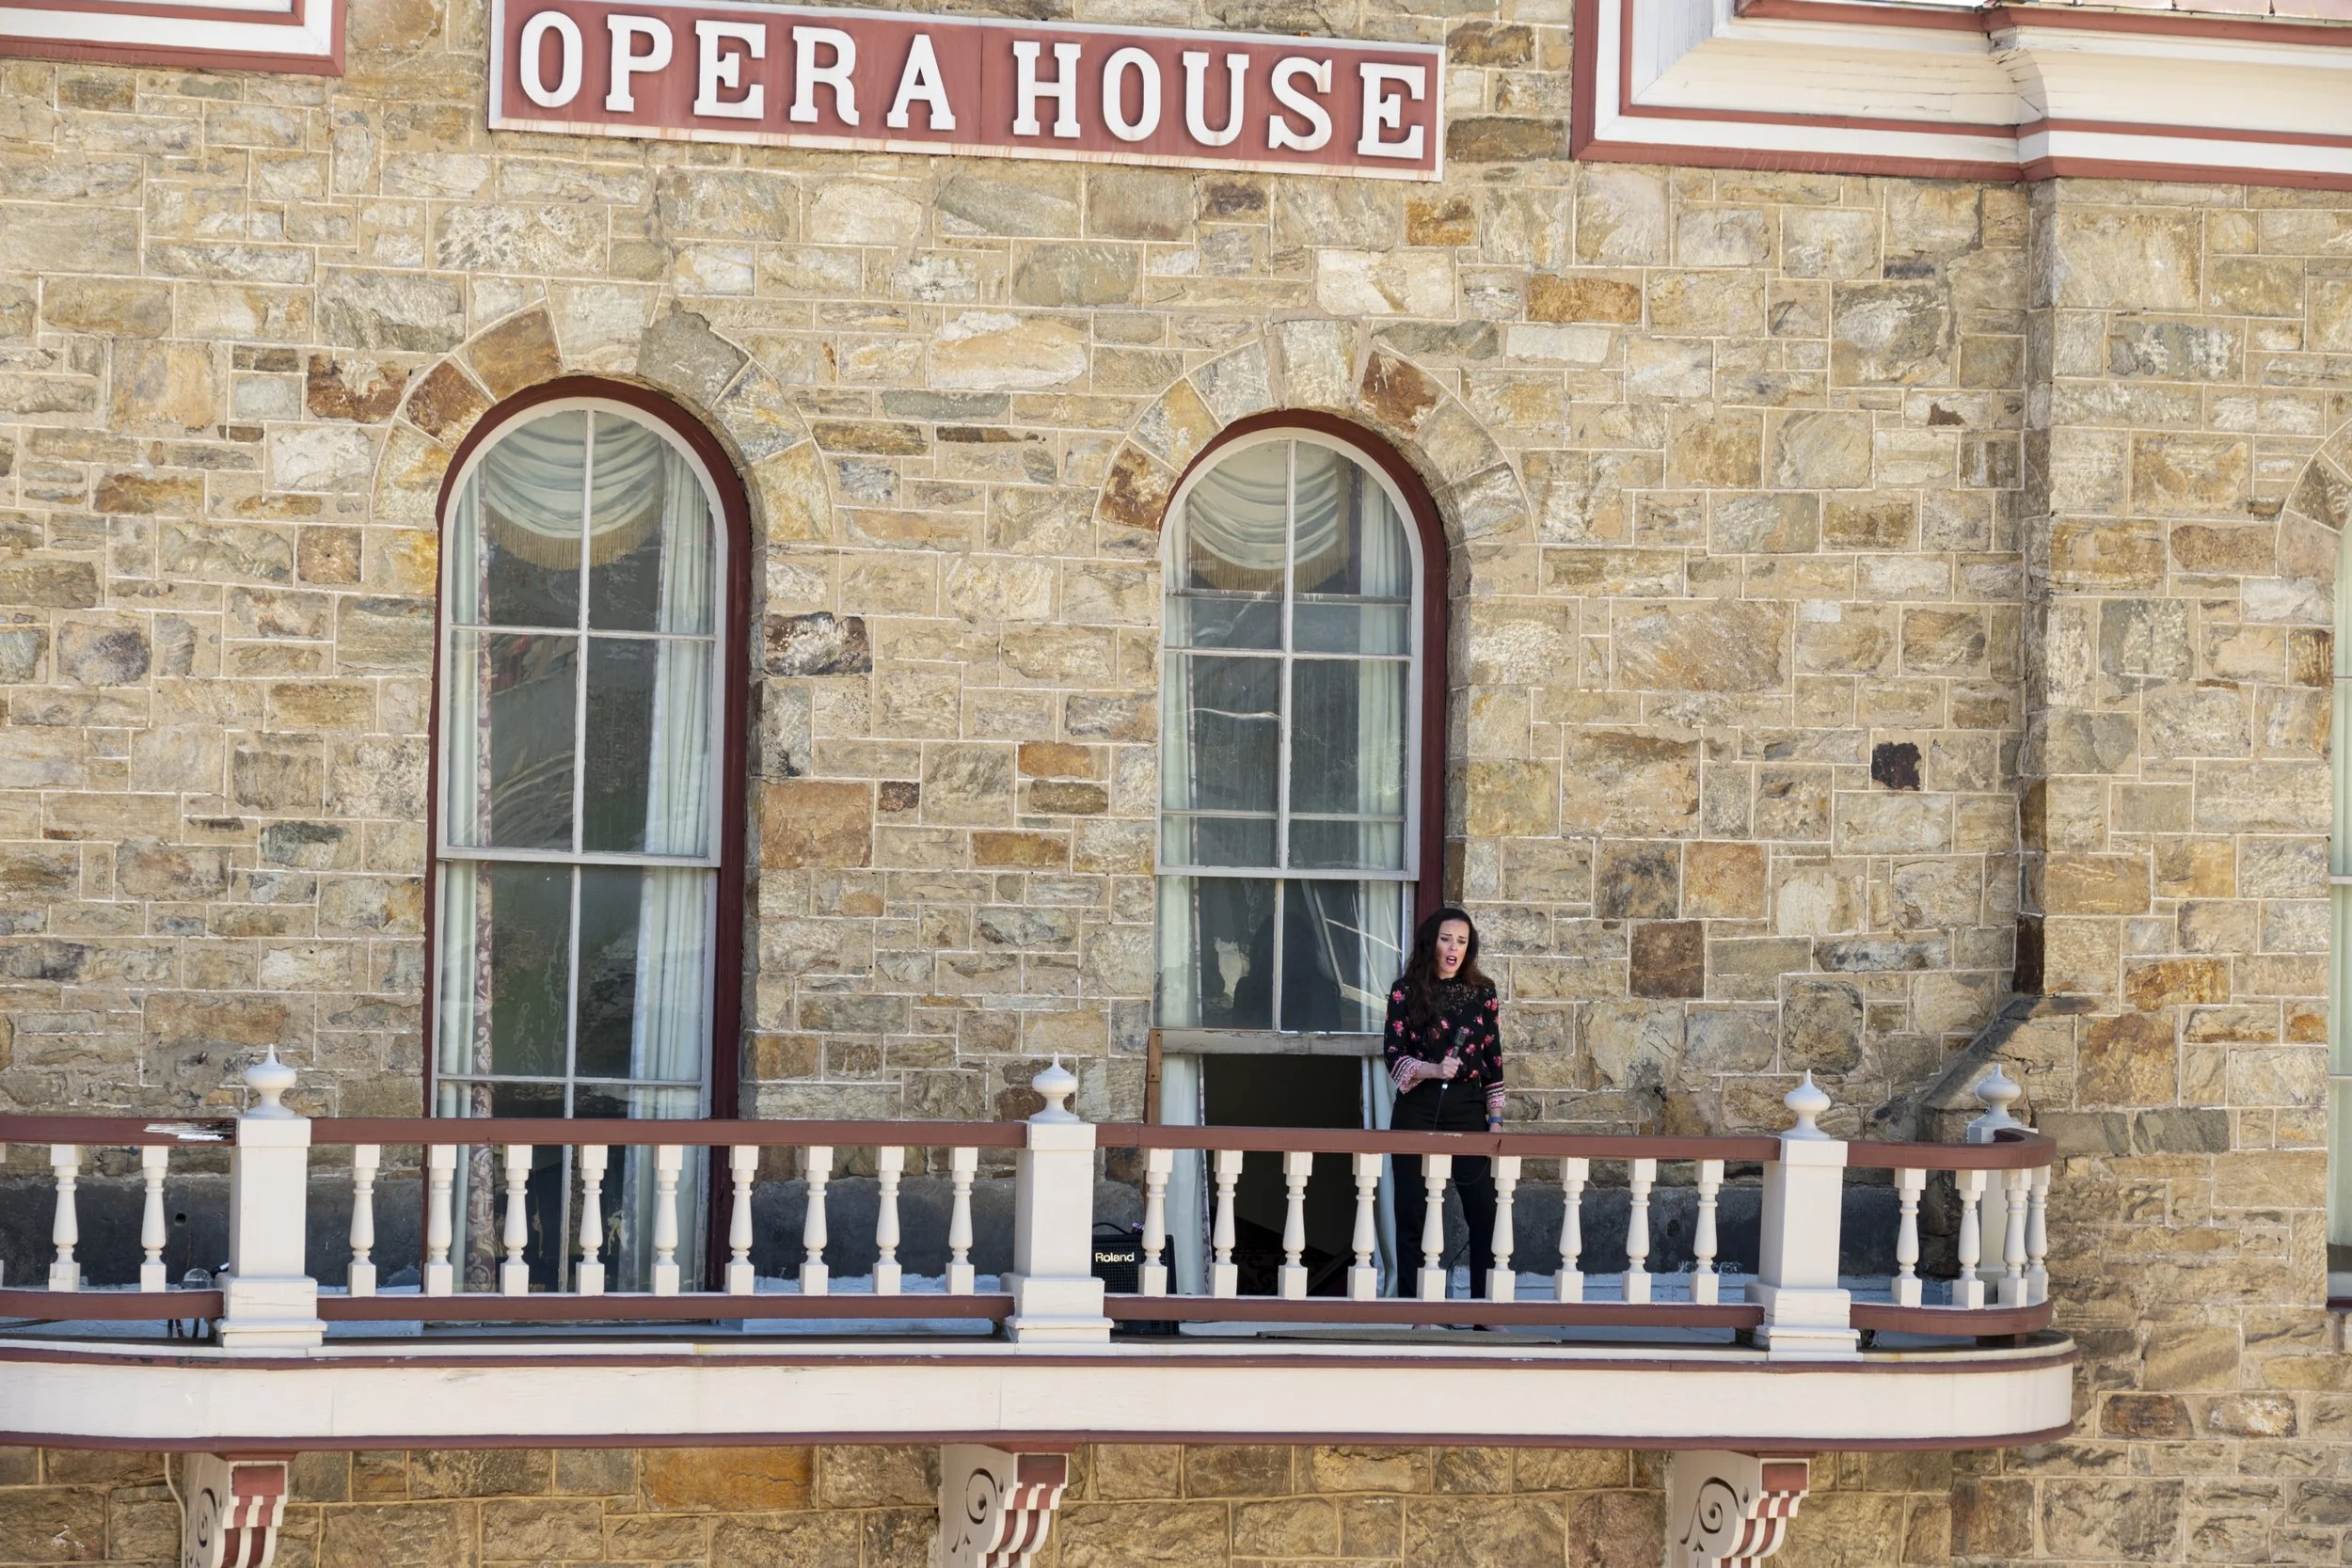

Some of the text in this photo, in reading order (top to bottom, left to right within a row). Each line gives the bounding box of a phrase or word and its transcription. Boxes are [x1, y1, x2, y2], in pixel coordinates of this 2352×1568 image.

[518, 12, 1424, 159] OPERA HOUSE
[1094, 1252, 1135, 1263] Roland
